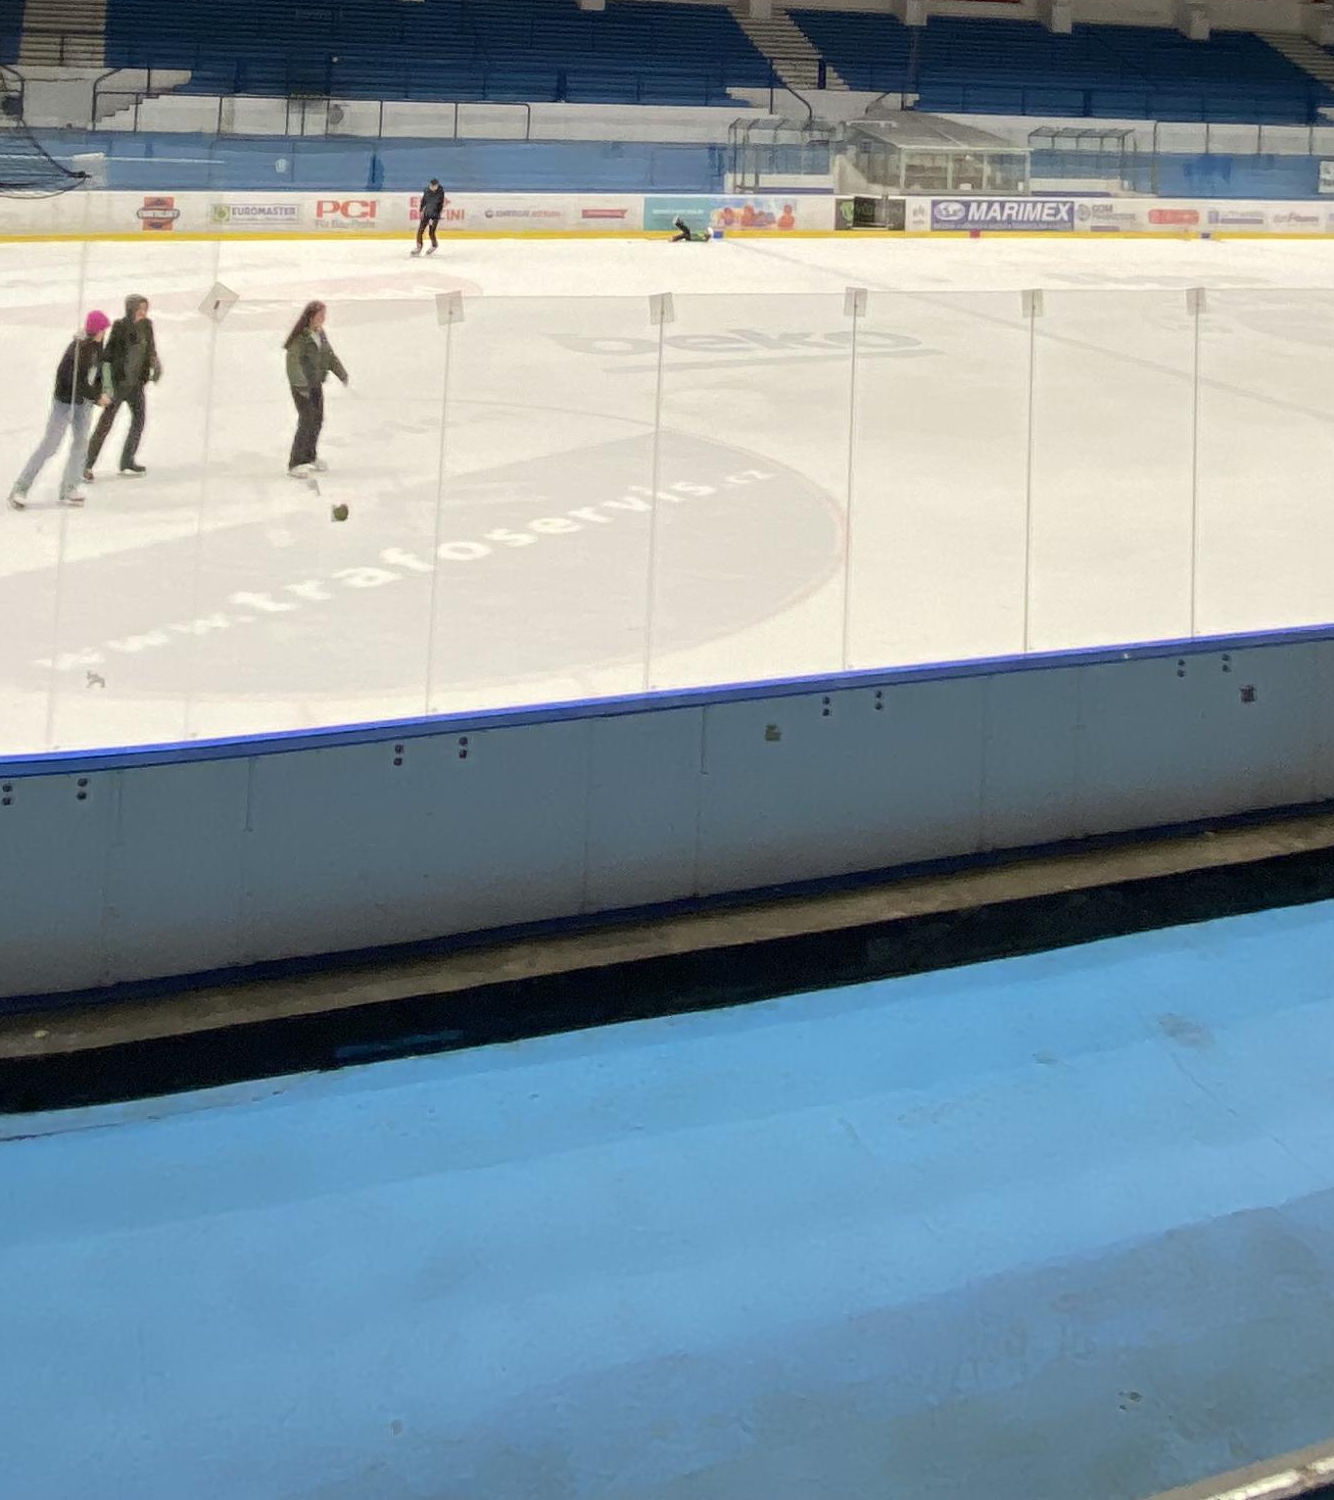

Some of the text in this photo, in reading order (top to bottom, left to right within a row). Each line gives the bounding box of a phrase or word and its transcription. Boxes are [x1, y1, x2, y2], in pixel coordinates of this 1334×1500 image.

[232, 206, 296, 216] EUROMASTER
[316, 200, 377, 219] PCI
[968, 202, 1071, 221] MARIMEX
[29, 466, 780, 672] www.trafoservis.cz
